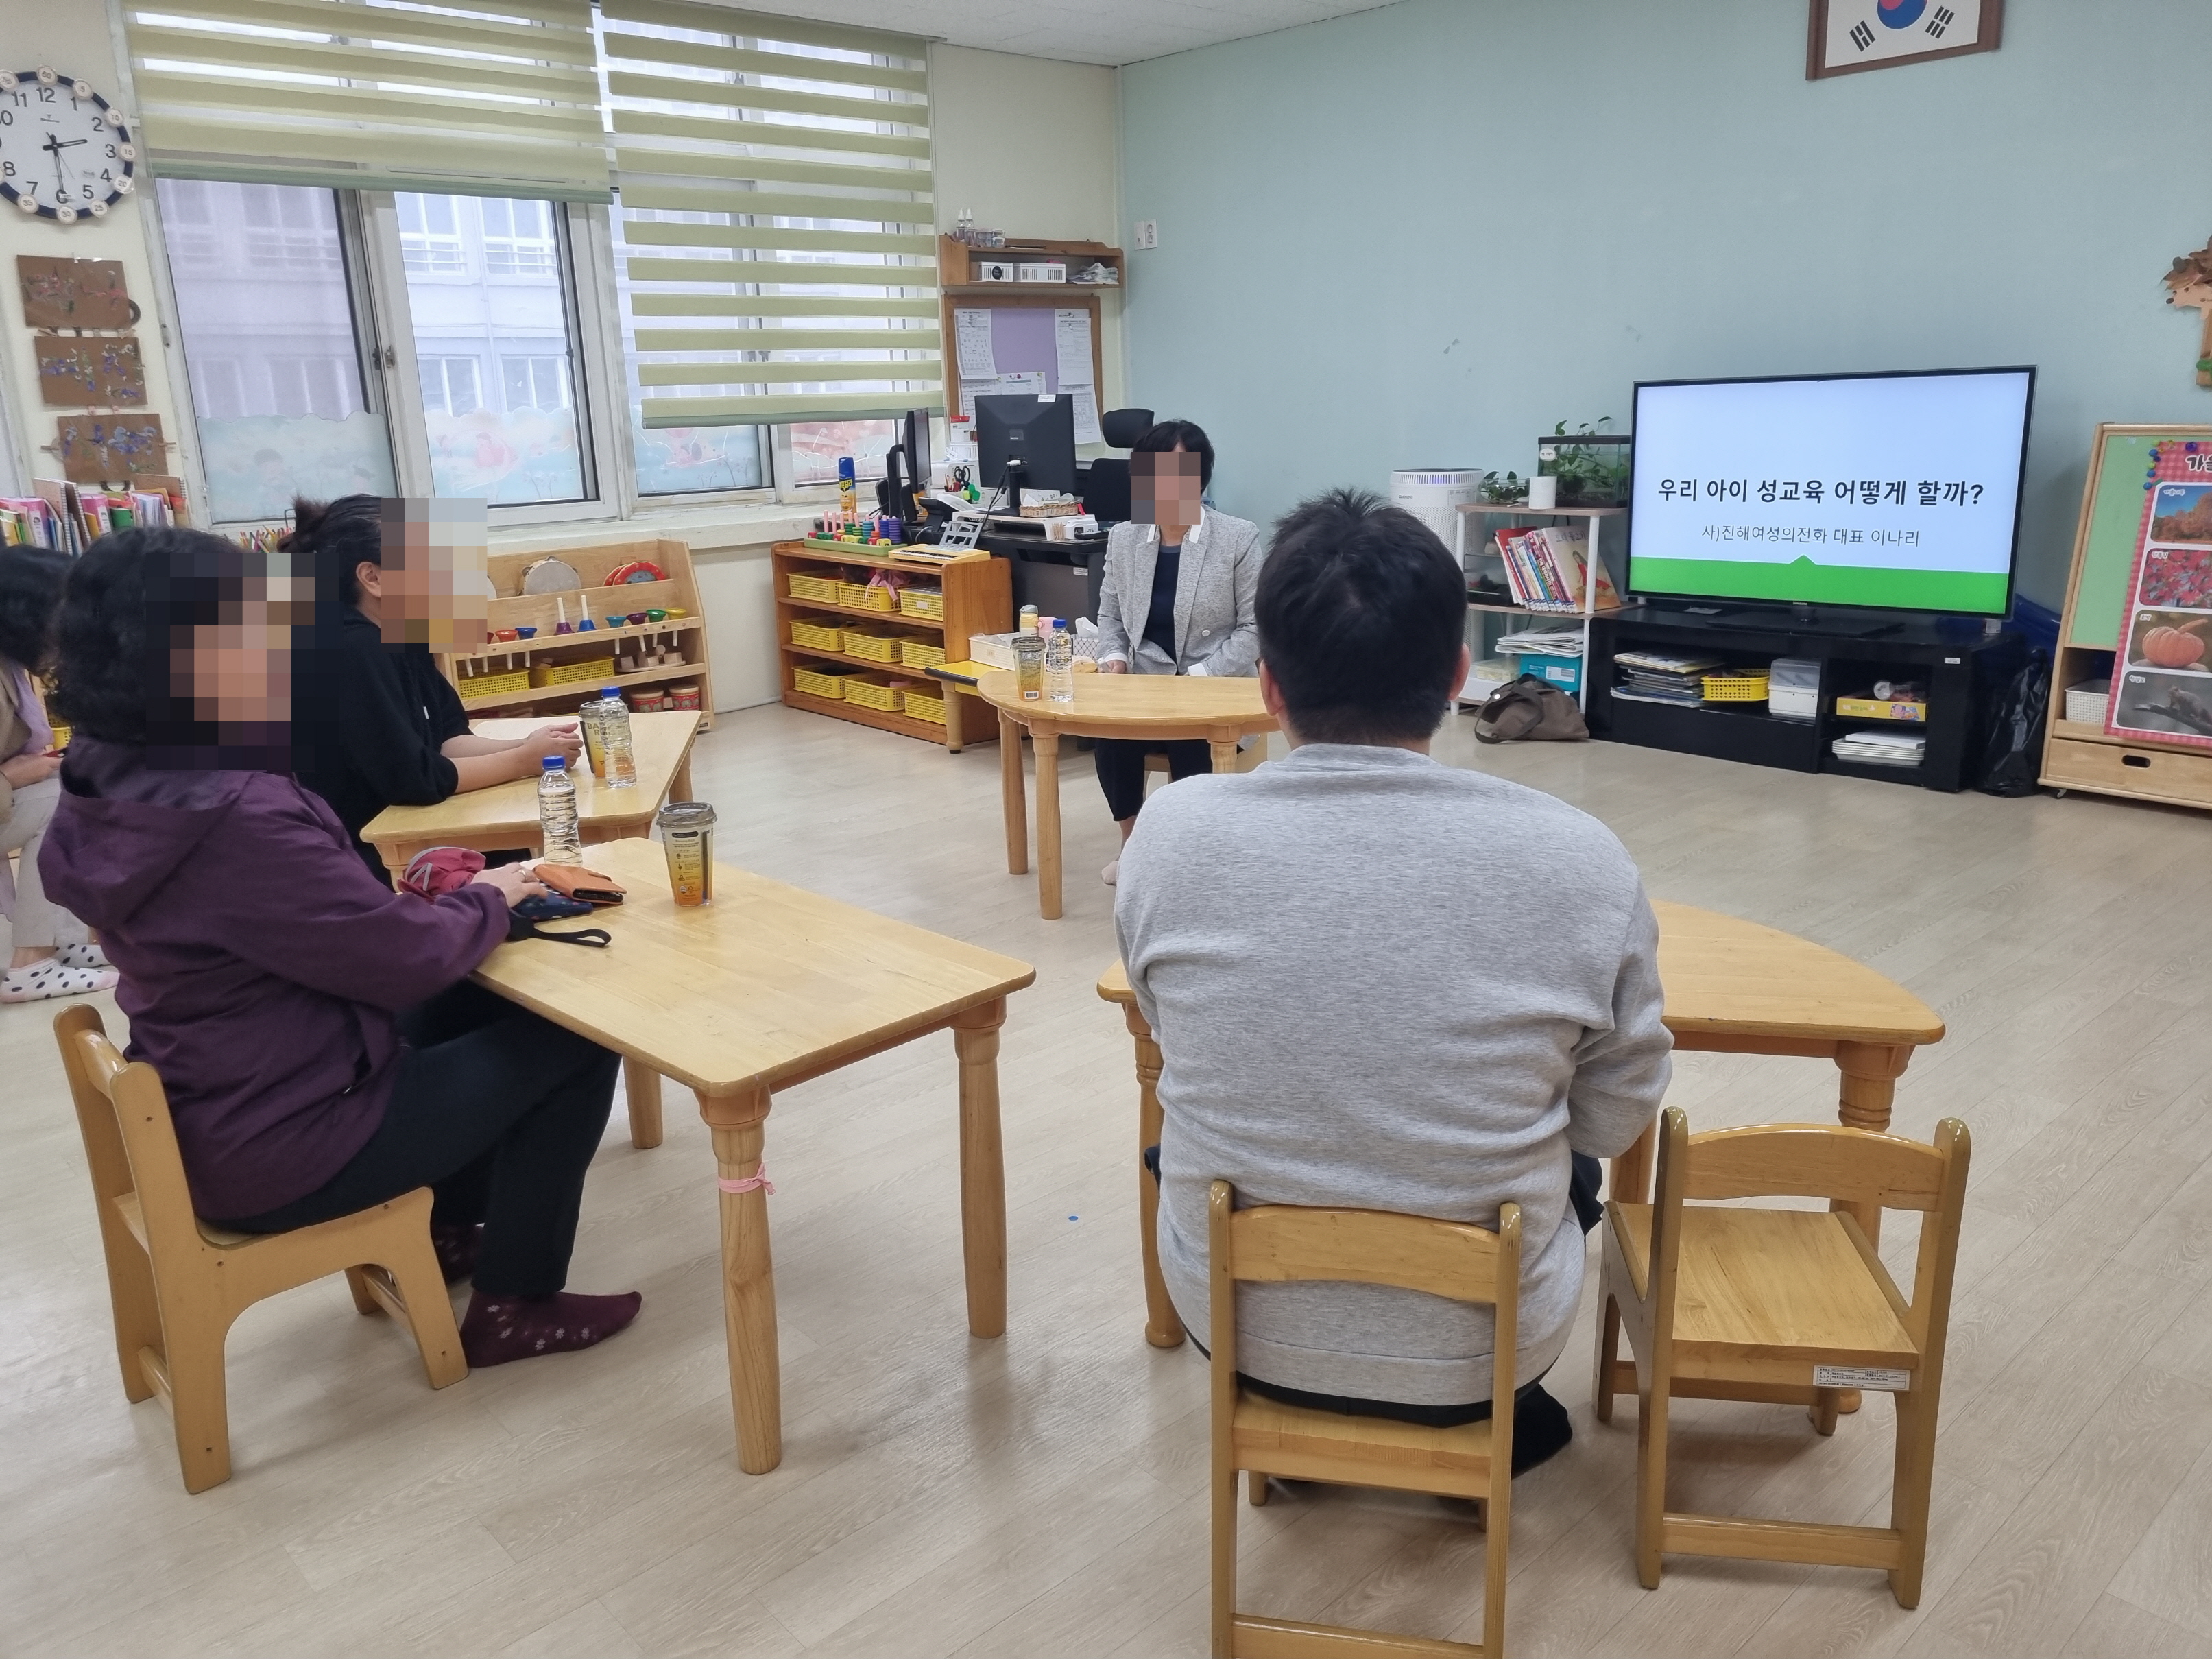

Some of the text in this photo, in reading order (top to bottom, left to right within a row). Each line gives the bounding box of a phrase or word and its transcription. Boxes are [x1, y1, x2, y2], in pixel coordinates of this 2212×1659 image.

[42, 71, 52, 80] 60
[11, 91, 28, 108] 11
[36, 87, 56, 104] 12
[70, 97, 77, 111] 1
[91, 117, 104, 132] 2
[111, 113, 120, 121] 10
[105, 143, 117, 159] 3
[124, 148, 133, 156] 15
[3, 160, 16, 176] 8
[100, 167, 112, 182] 4
[26, 180, 38, 195] 7
[82, 184, 95, 200] 5
[1658, 479, 1984, 507] 우리 아이 성교육 어떻게 할까?
[1701, 525, 1919, 548] 사)진해여성의전화 대표 이나리
